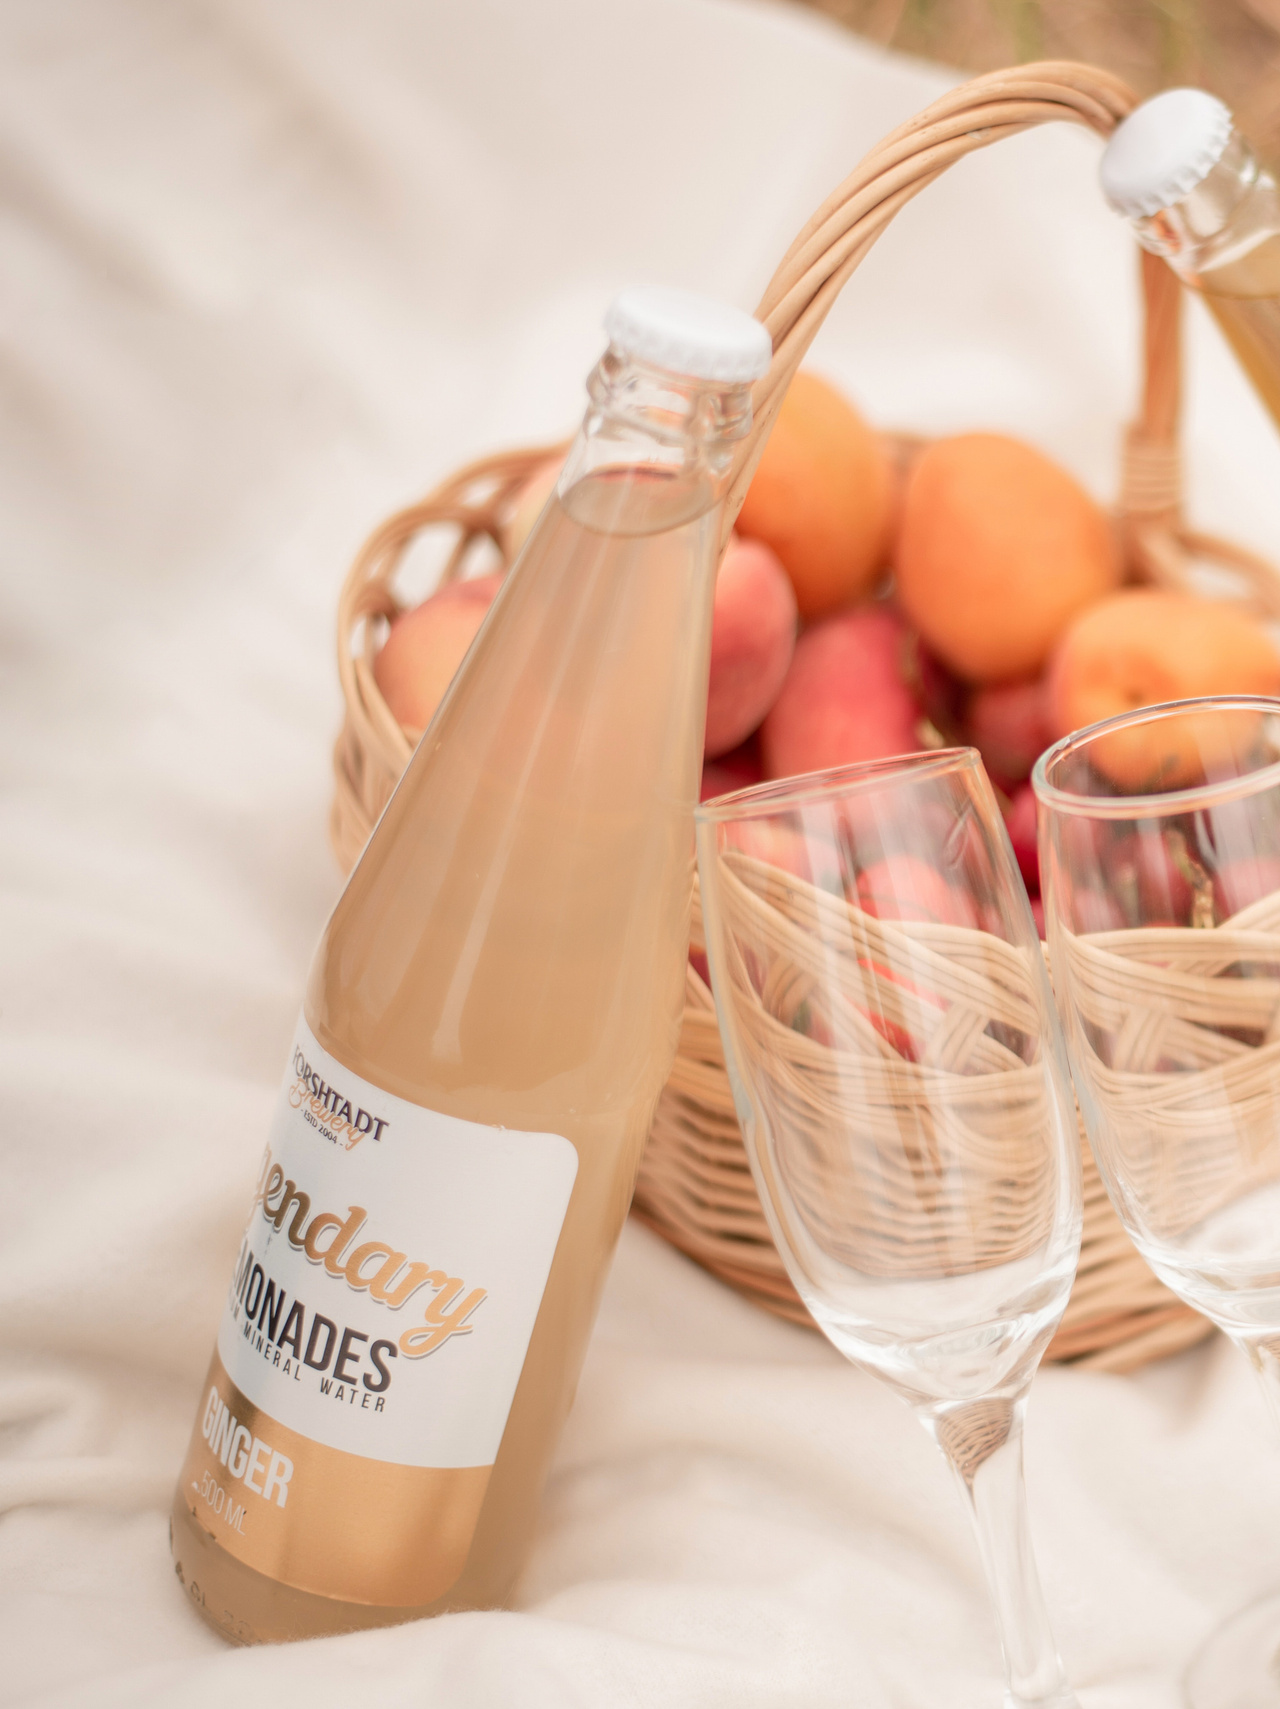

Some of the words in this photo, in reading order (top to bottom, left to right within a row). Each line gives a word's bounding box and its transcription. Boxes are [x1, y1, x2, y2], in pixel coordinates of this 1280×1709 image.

[289, 1077, 365, 1151] Brewery
[303, 1109, 318, 1128] ESTD
[318, 1123, 338, 1144] 2004
[243, 1320, 301, 1382] MINERAL
[319, 1376, 386, 1412] WATER
[202, 1385, 294, 1509] GINGER
[200, 1469, 225, 1514] 500
[224, 1497, 245, 1536] ML
